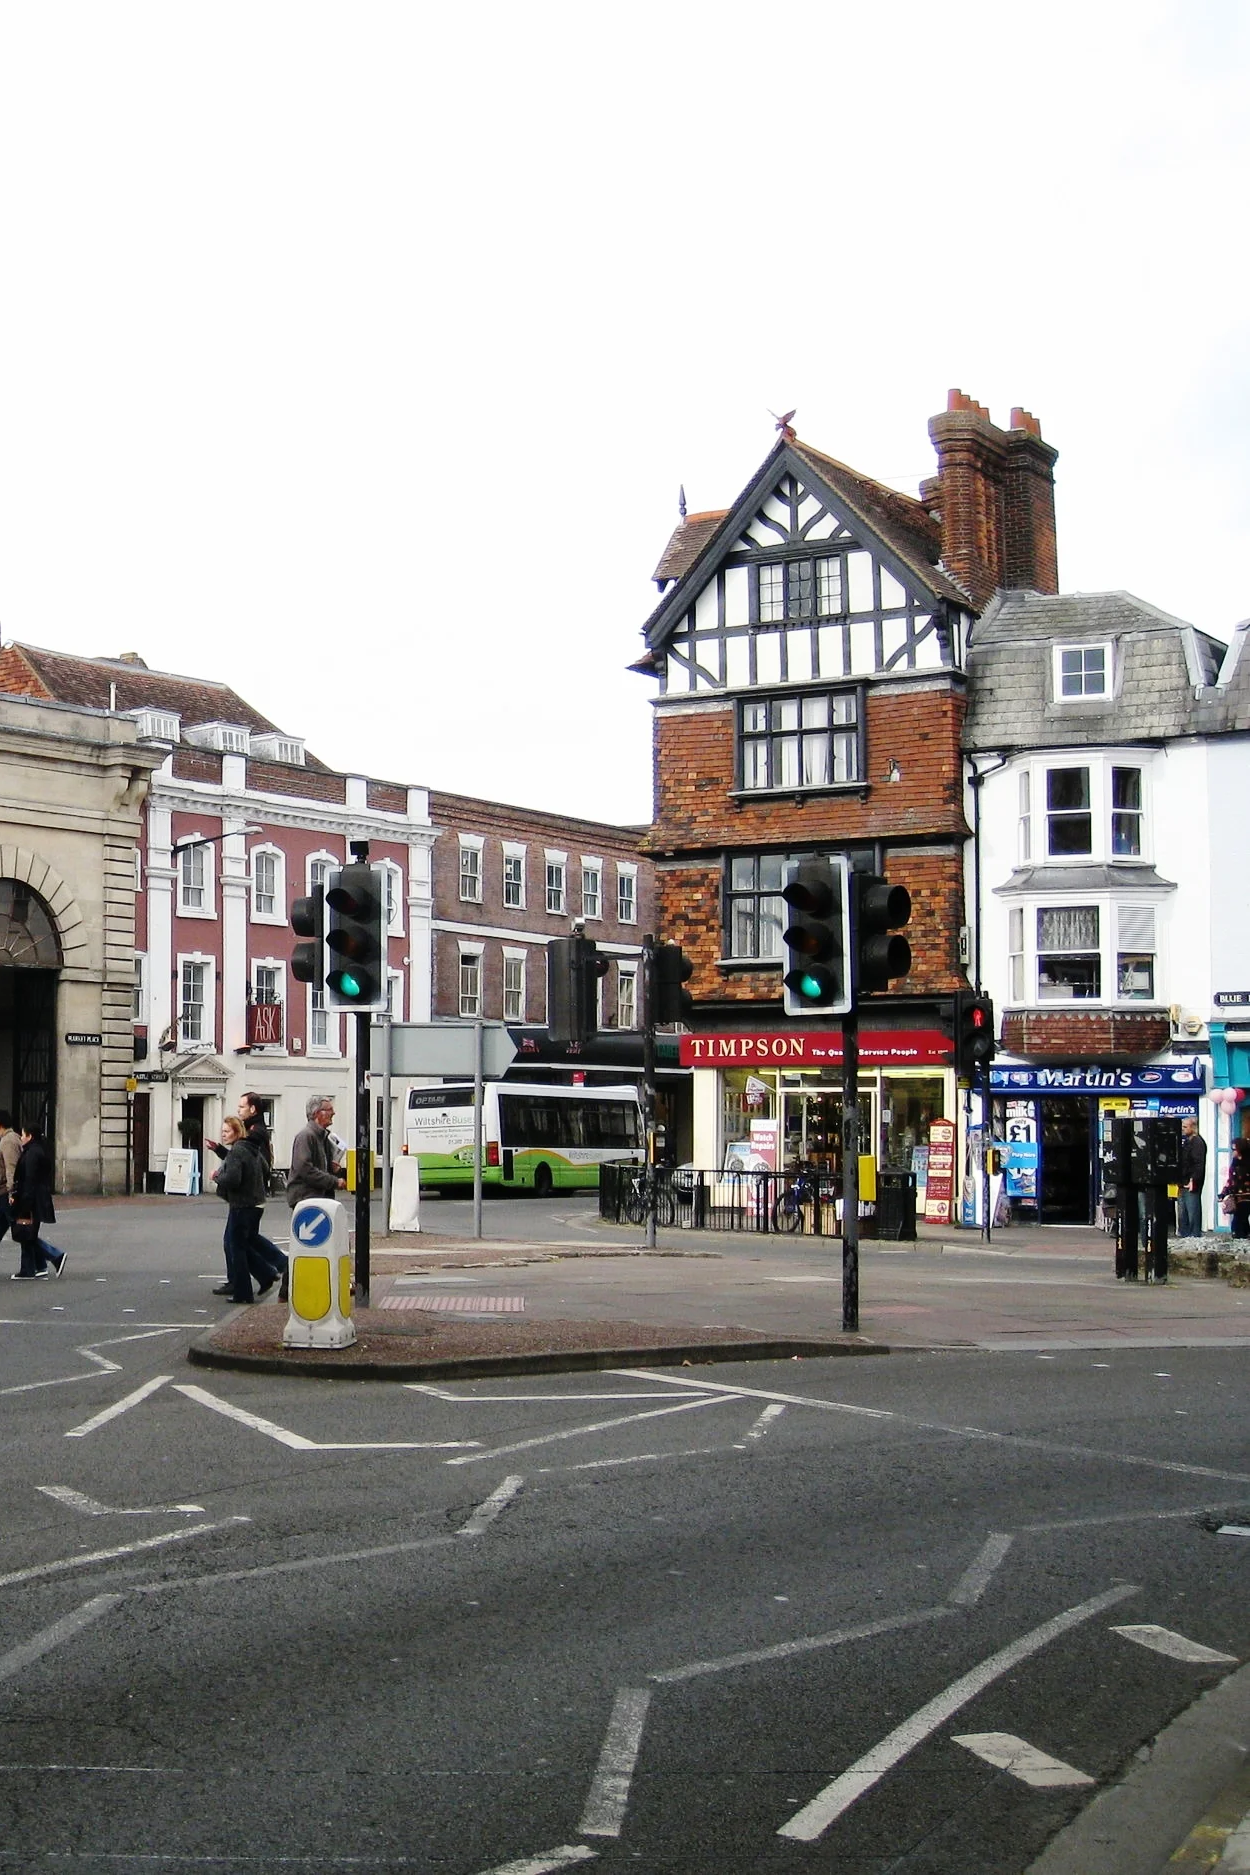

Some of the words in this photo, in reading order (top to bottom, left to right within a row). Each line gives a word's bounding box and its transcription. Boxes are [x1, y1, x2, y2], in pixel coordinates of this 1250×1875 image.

[1220, 994, 1242, 1003] BLUE
[254, 1007, 276, 1041] ASK
[690, 1038, 806, 1057] TIMPSON
[891, 1049, 918, 1057] People
[1040, 1068, 1132, 1087] Martin's
[1005, 1106, 1028, 1118] milk
[1159, 1105, 1195, 1114] Martin's
[753, 1133, 773, 1141] Watch
[1010, 1124, 1031, 1142] £1
[751, 1141, 775, 1151] Repairs
